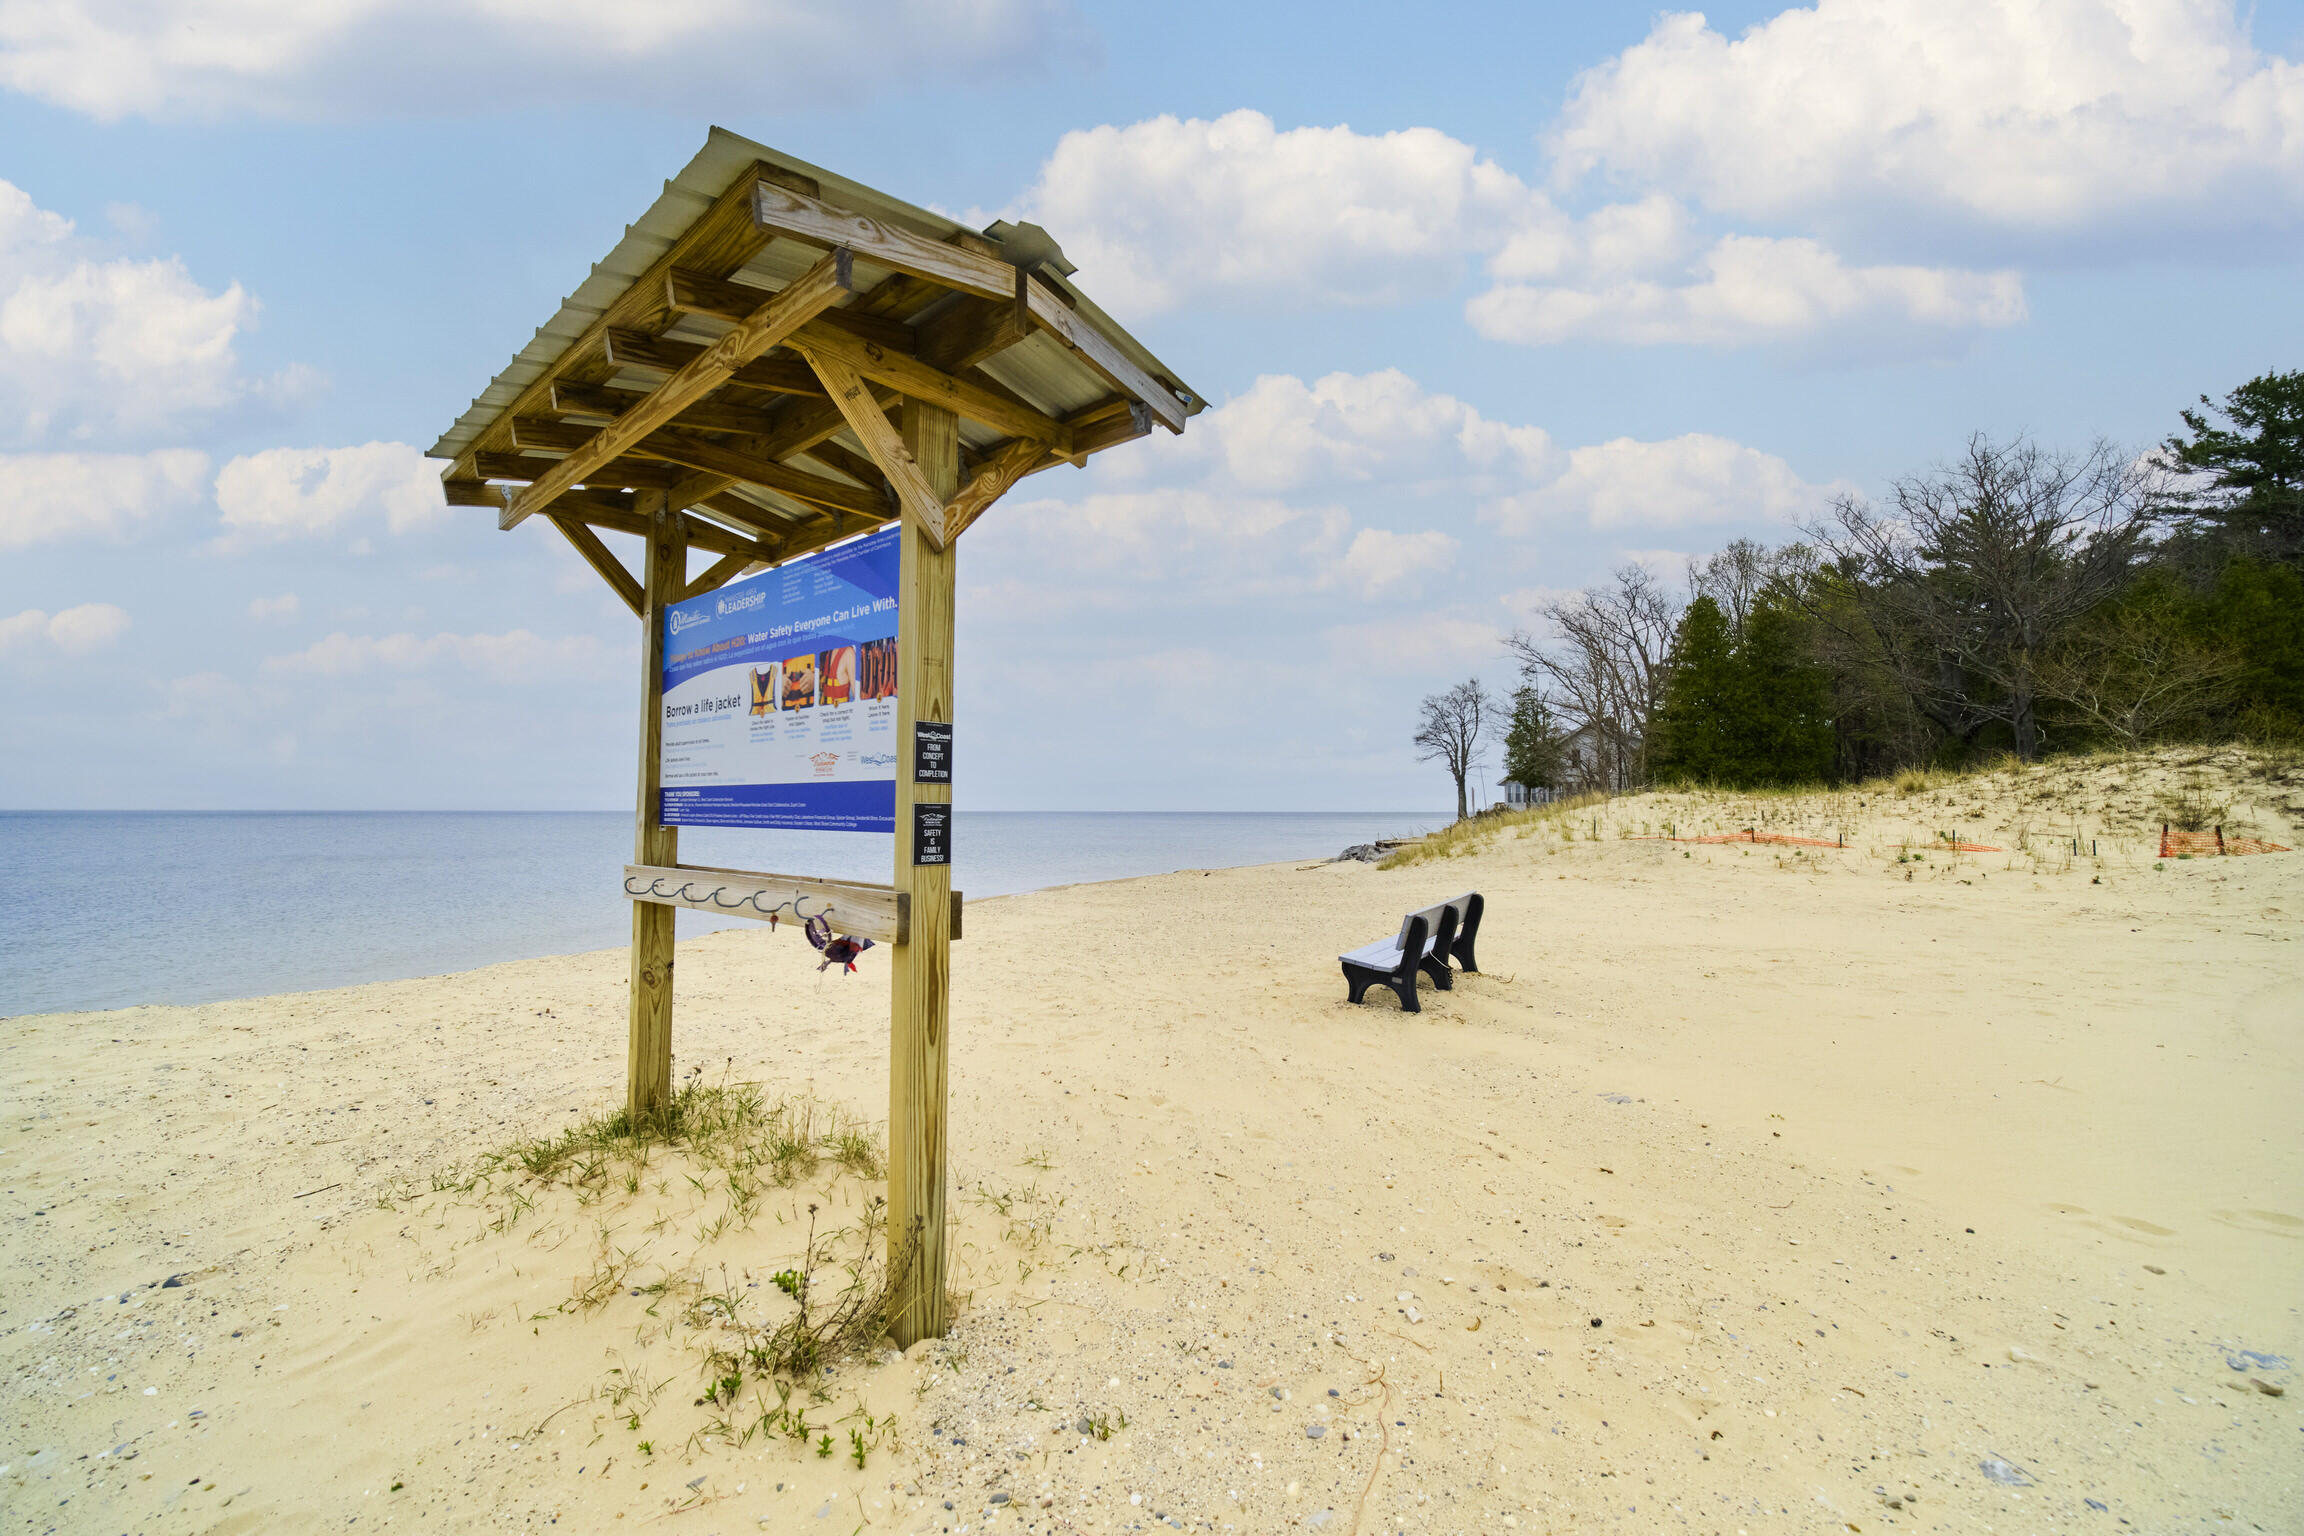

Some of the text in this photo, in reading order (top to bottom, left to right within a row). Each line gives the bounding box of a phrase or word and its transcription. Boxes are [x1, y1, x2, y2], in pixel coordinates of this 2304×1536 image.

[724, 591, 766, 614] LEADERSHIP
[747, 630, 768, 644] Water
[770, 624, 793, 639] Safety
[794, 615, 831, 633] Everyone
[833, 610, 849, 623] Can
[851, 605, 870, 618] Live
[872, 595, 898, 613] With.
[666, 694, 741, 718] Borrow a life jacket
[917, 731, 930, 739] West
[927, 743, 941, 752] FROM
[861, 755, 875, 765] West
[922, 751, 944, 760] CONCEPT
[930, 760, 937, 769] TO
[918, 769, 948, 778] COMPLETION
[923, 829, 942, 837] SAFETY
[930, 837, 936, 846] IS
[923, 846, 942, 854] FAMILY
[920, 854, 945, 863] BUSINESS!
